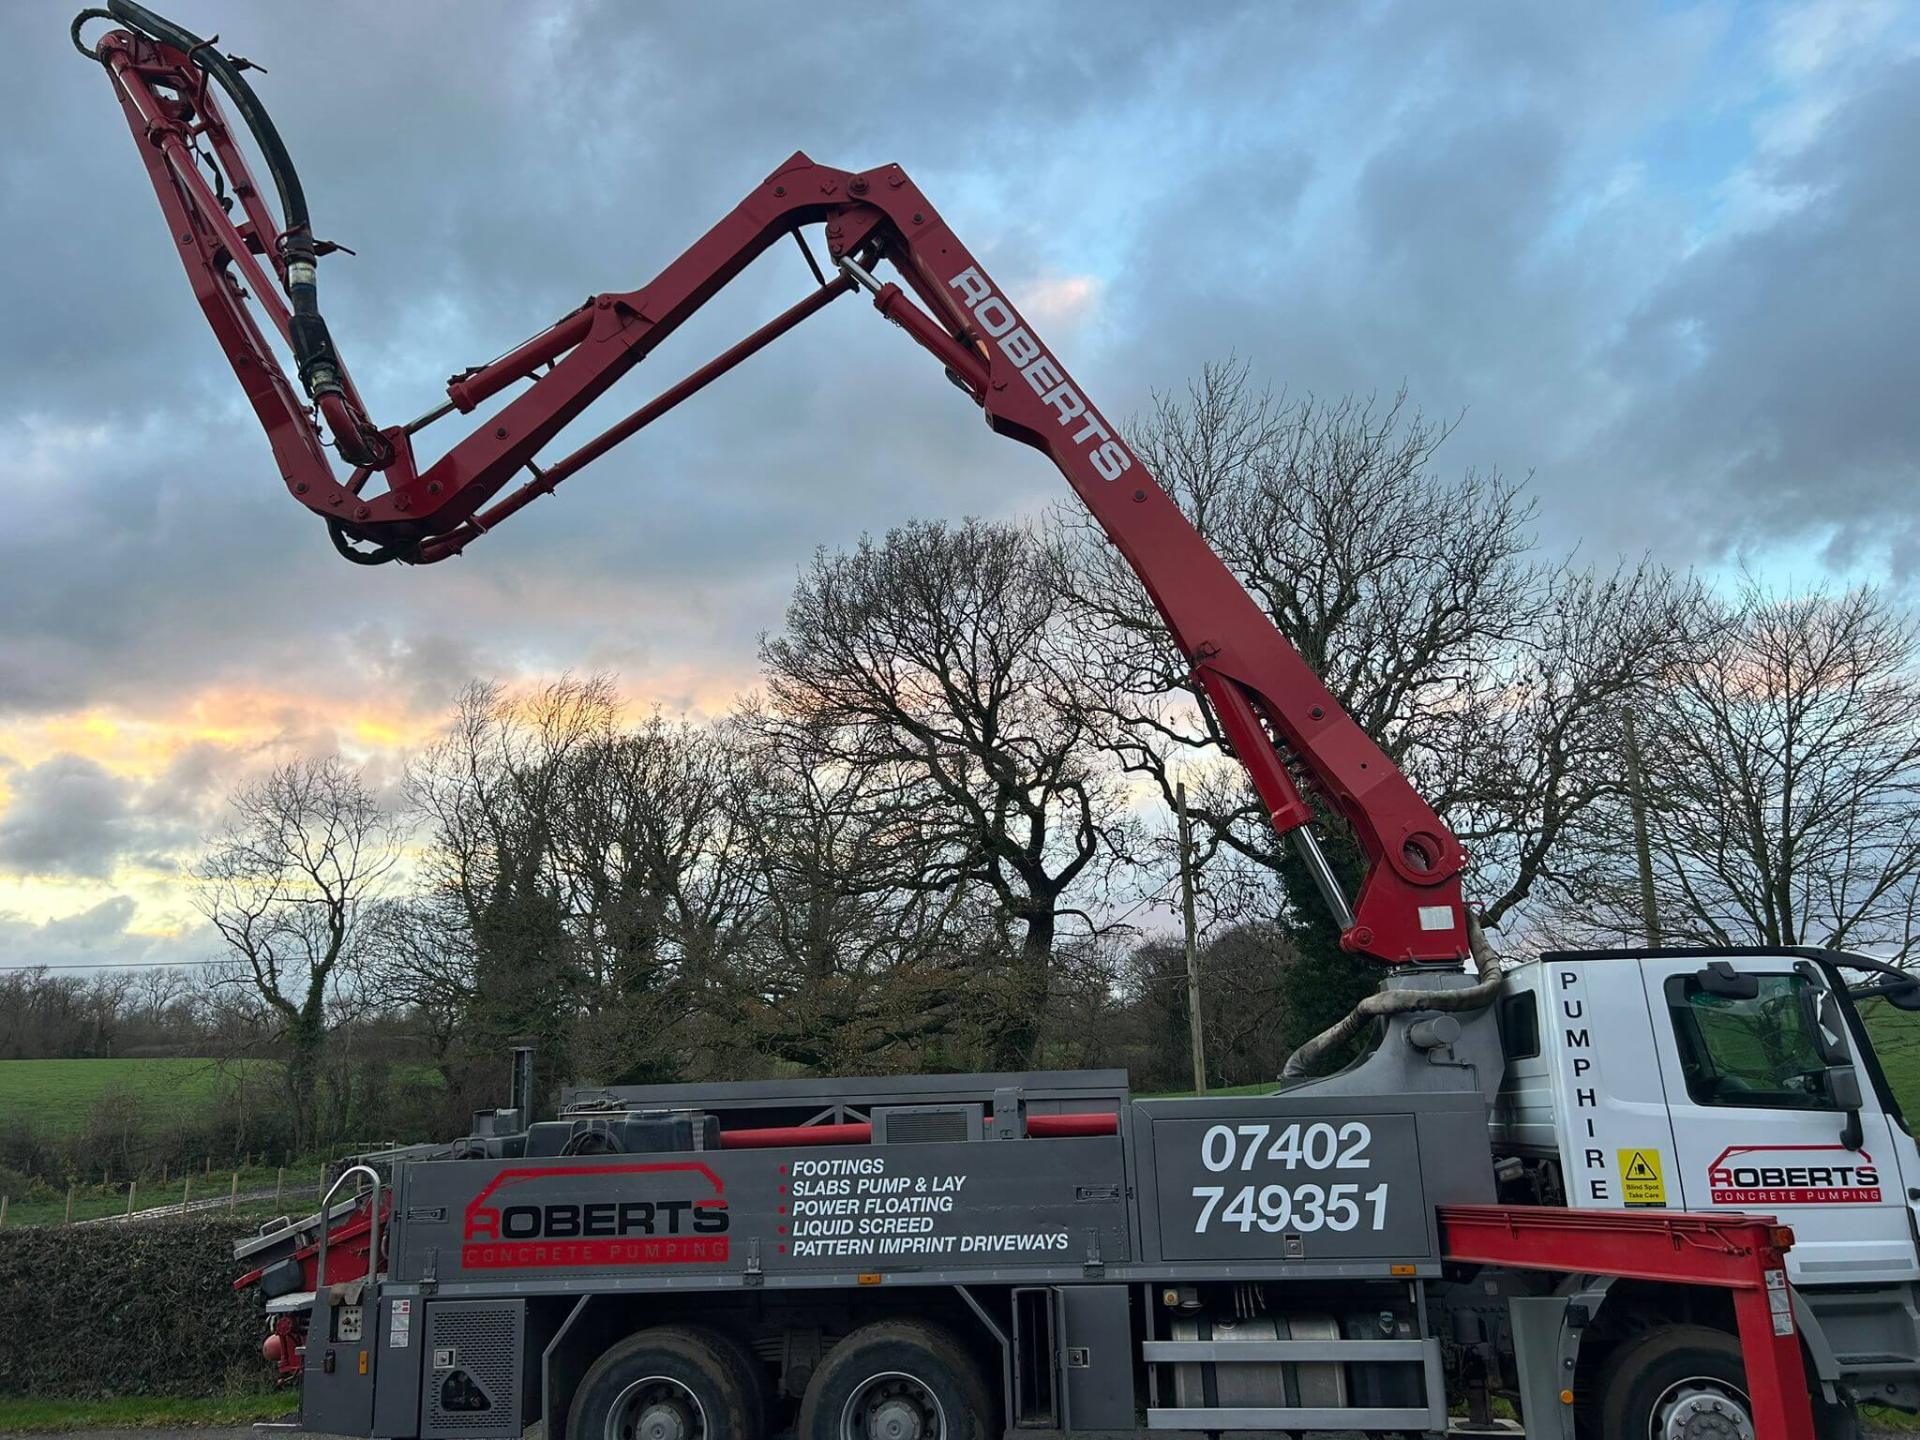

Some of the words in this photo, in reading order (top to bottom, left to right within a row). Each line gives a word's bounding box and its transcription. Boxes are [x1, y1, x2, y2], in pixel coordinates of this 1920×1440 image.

[948, 265, 1132, 482] ROBERTS
[1201, 1121, 1372, 1172] 07402
[792, 1158, 884, 1176] FOOTINGS
[1708, 1166, 1880, 1188] ROBERTS
[792, 1179, 851, 1196] SLABS
[857, 1177, 911, 1195] PUMP
[915, 1177, 928, 1193] &
[932, 1175, 966, 1192] LAY
[1644, 1183, 1659, 1191] Spot
[1713, 1191, 1797, 1201] CONCRETE
[1806, 1190, 1879, 1200] PUMPING
[792, 1200, 859, 1217] POWER
[864, 1196, 953, 1215] FLOATING
[1191, 1183, 1388, 1233] 749351
[464, 1200, 730, 1240] ROBERTS
[792, 1220, 854, 1237] LIQUID
[858, 1217, 934, 1235] SCREED
[465, 1246, 593, 1264] CONCRETE
[609, 1242, 726, 1259] PUMPING
[792, 1239, 874, 1257] PATTERN
[879, 1236, 957, 1254] IMPRINT
[960, 1233, 1069, 1253] DRIVEWAYS
